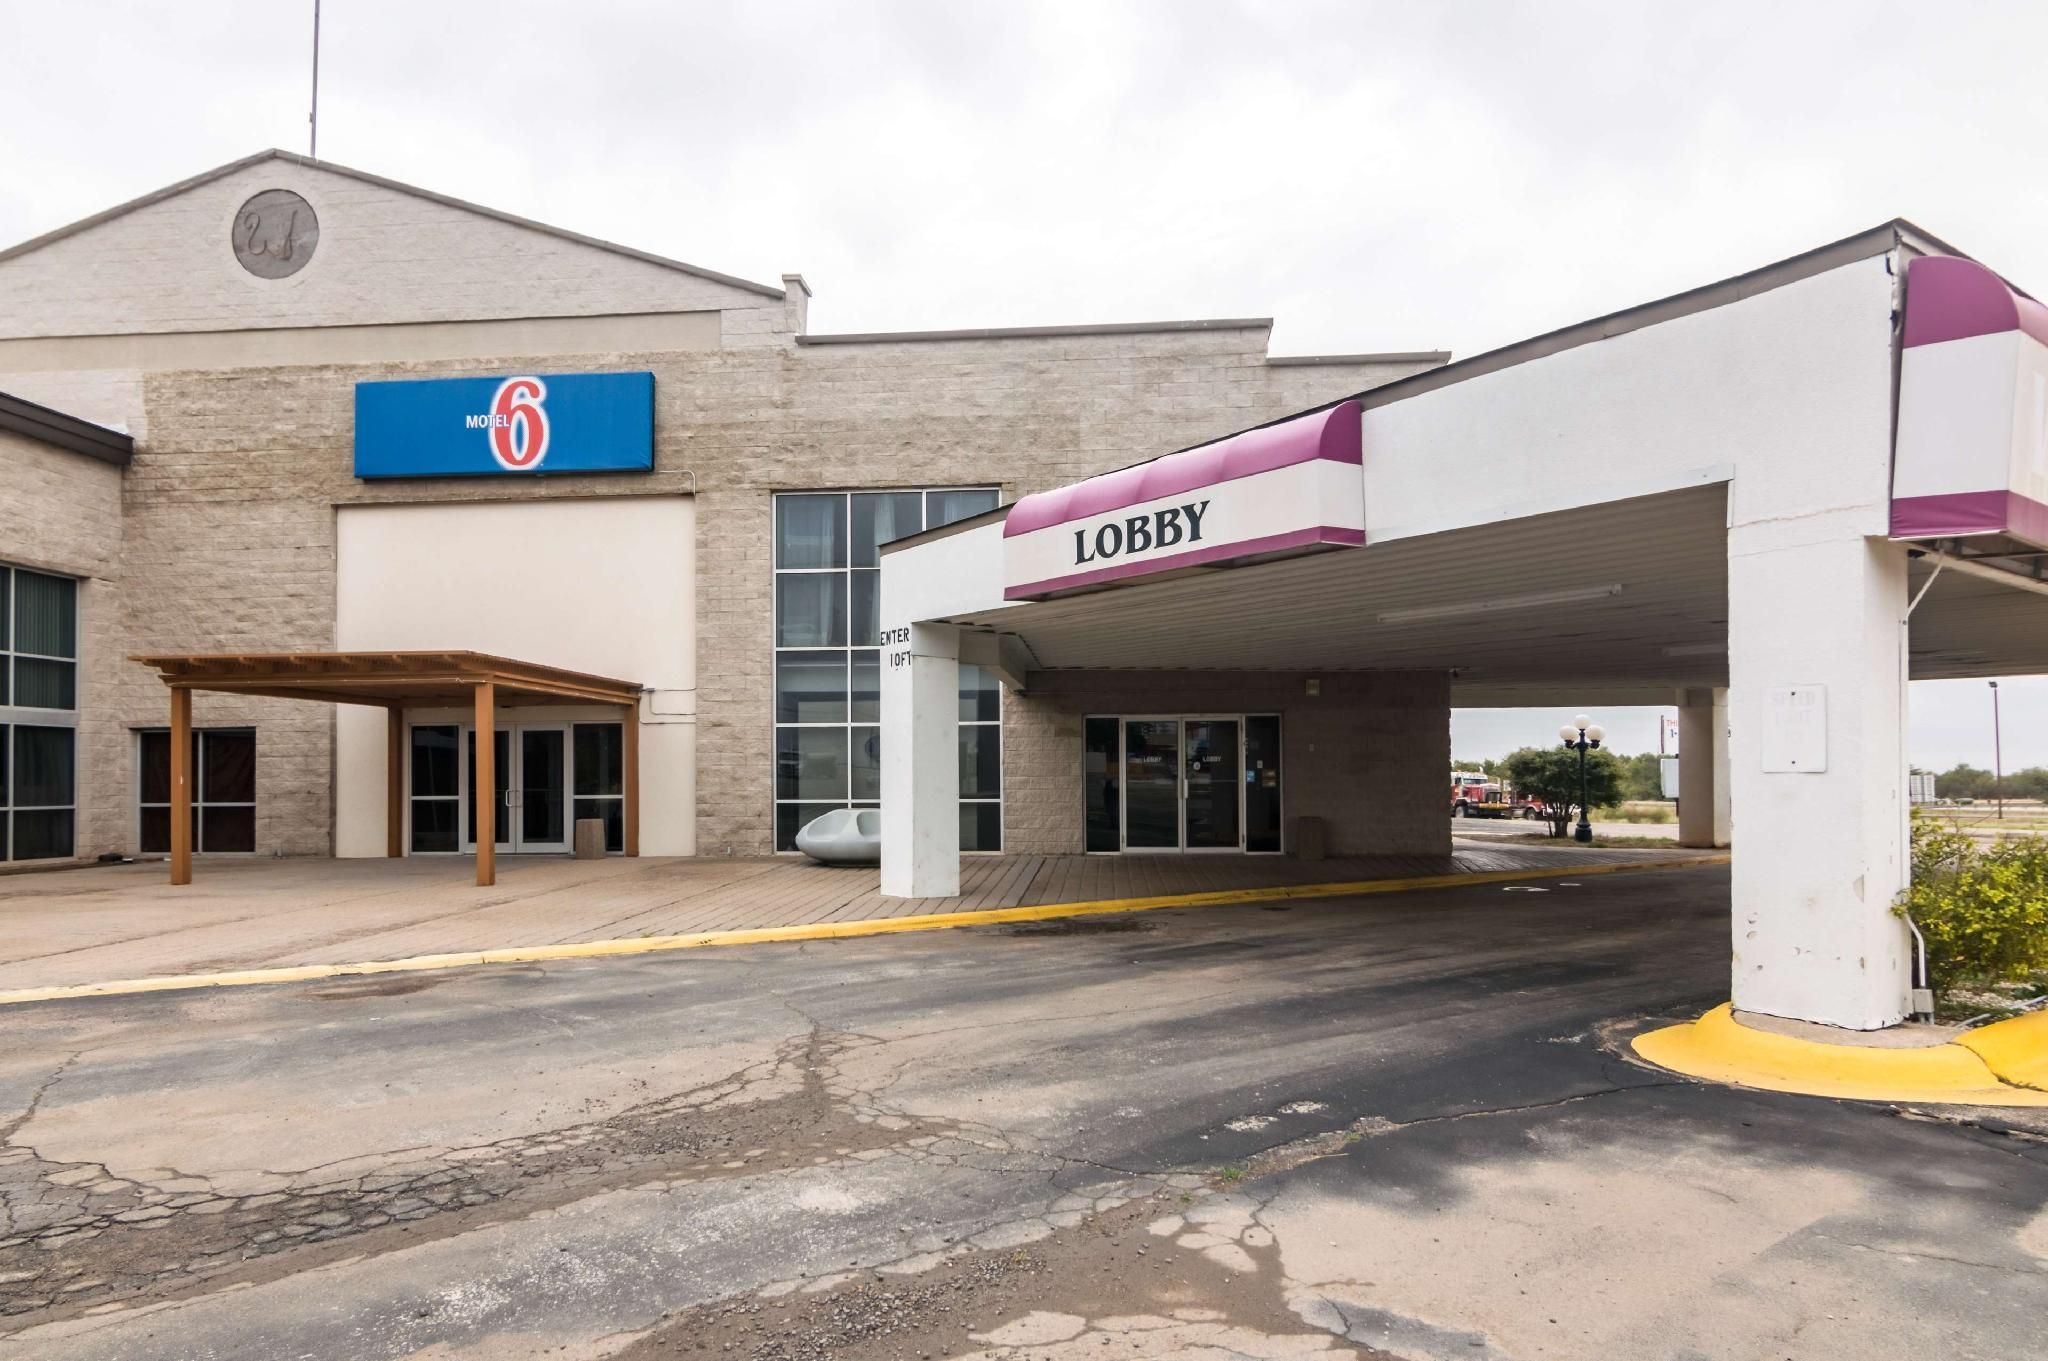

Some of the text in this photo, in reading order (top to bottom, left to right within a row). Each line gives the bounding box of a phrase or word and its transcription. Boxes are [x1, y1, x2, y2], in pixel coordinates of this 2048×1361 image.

[466, 377, 549, 470] MOTEL 6
[1074, 500, 1211, 566] LOBBY
